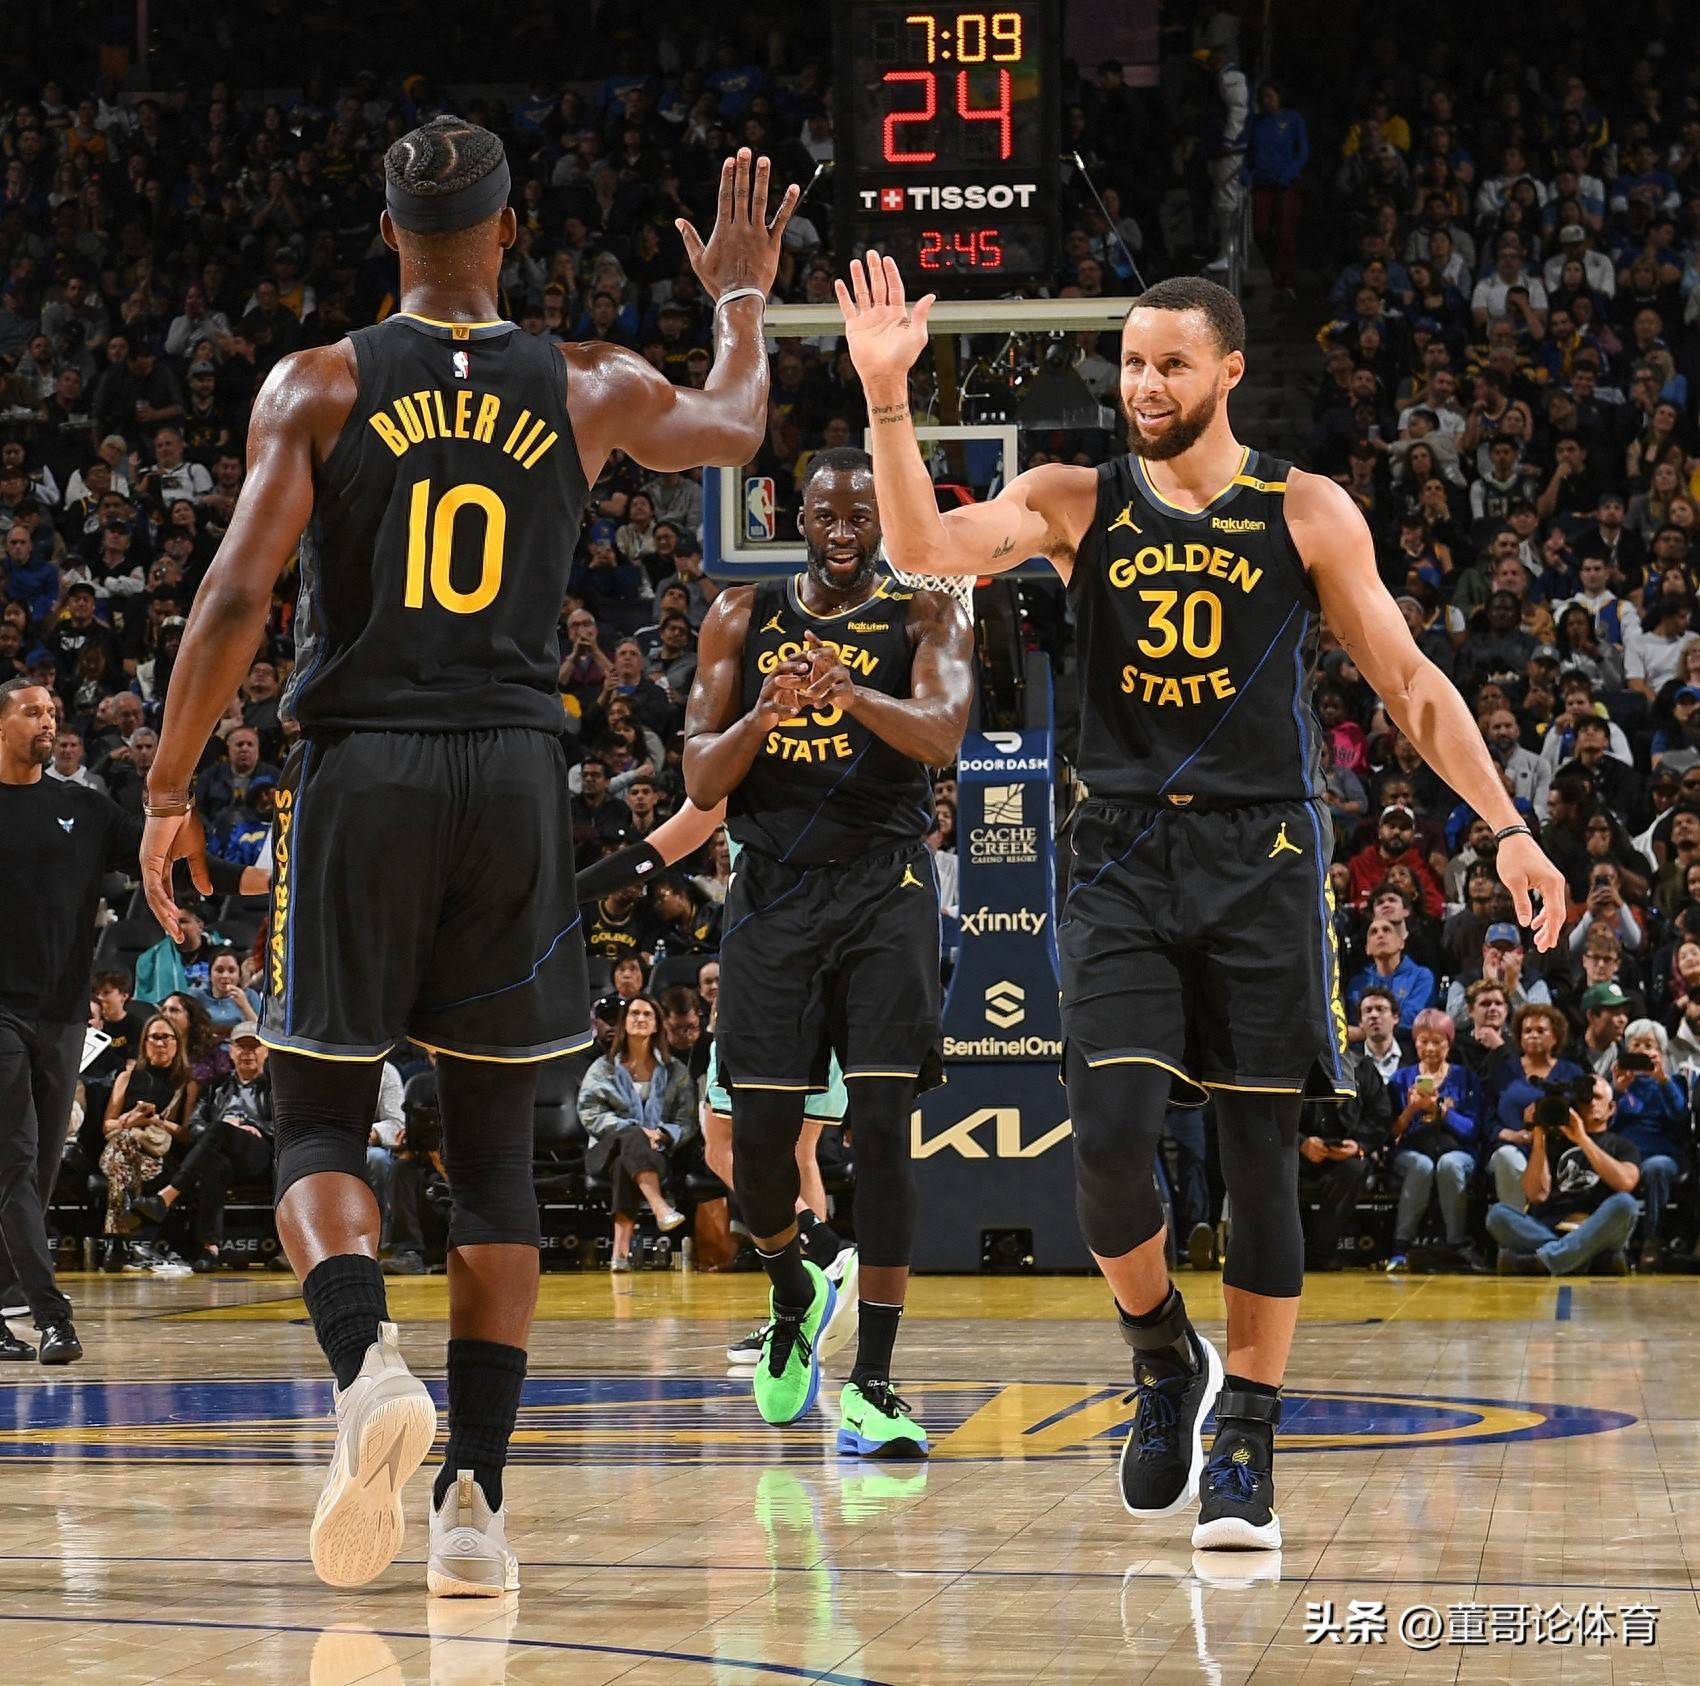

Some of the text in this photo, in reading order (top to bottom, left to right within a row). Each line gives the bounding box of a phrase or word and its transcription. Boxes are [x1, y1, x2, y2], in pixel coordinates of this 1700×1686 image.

[906, 13, 1021, 63] 7:09
[883, 69, 1010, 162] 24
[907, 184, 1036, 210] TISSOT
[919, 230, 1002, 268] 2:45
[368, 389, 559, 470] BUTLER III
[1212, 517, 1266, 531] Rakuten
[404, 478, 507, 614] 10
[1109, 543, 1263, 593] GOLDEN
[847, 621, 889, 631] Rakuten
[1137, 590, 1222, 659] 30
[1121, 665, 1236, 707] STATE
[766, 731, 853, 763] STATE
[960, 758, 1048, 771] DOORDASH
[970, 827, 1037, 842] CACHE
[970, 841, 1037, 856] CREEK
[971, 855, 1038, 864] CASINO RESORT
[960, 906, 1048, 936] xfinity
[591, 932, 636, 947] GOLDEN
